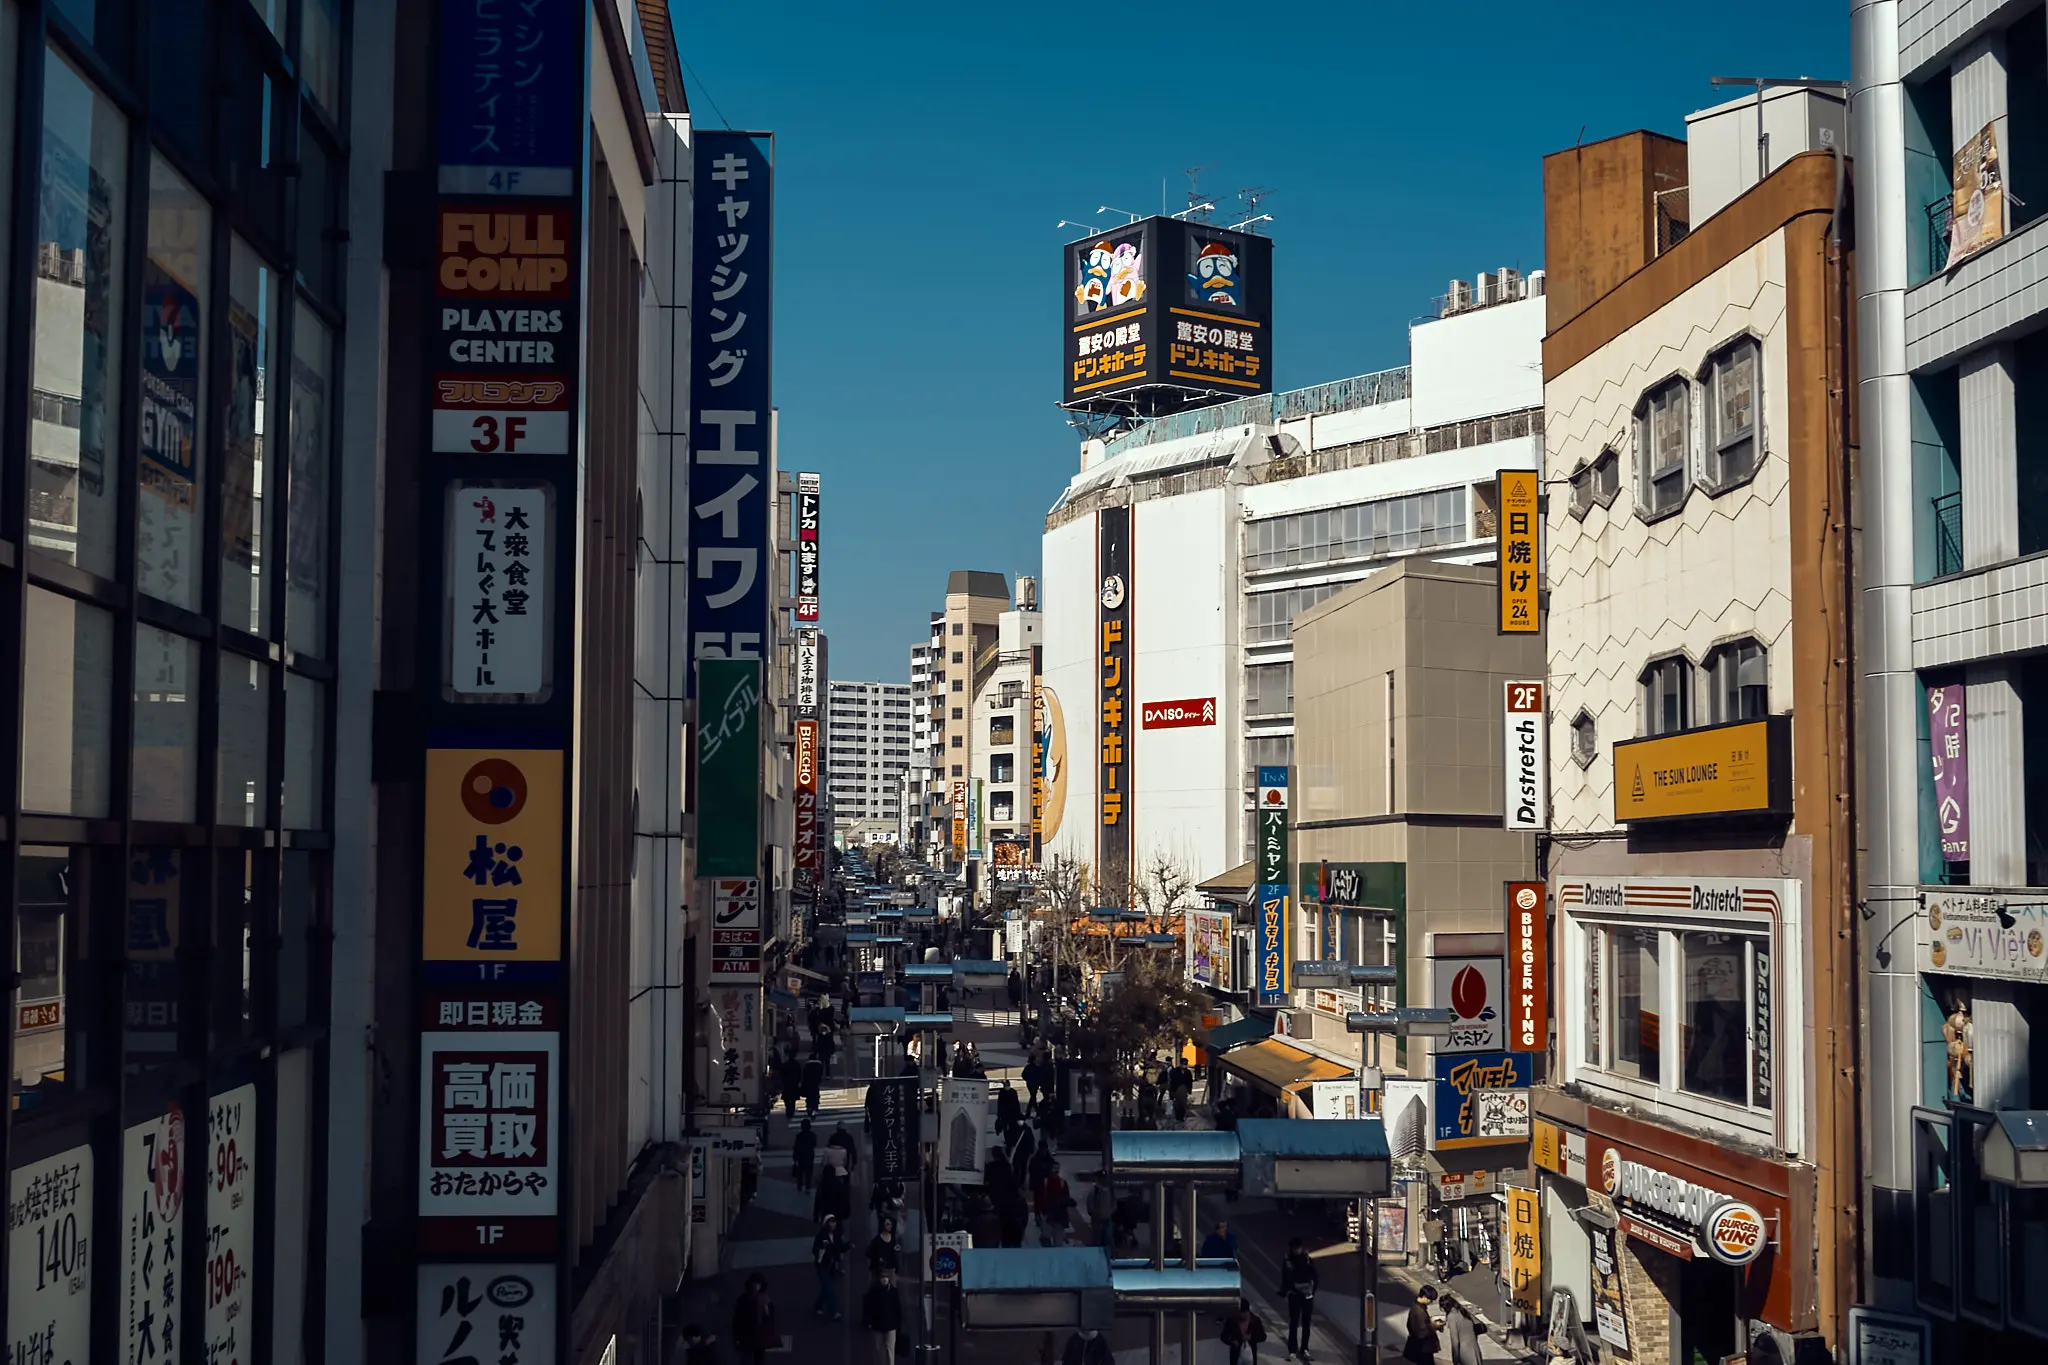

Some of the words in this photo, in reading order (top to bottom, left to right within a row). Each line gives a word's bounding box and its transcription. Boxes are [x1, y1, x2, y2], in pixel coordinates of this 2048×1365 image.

[488, 171, 521, 192] 4F
[442, 212, 565, 254] FULL
[440, 256, 568, 292] COMP
[708, 153, 750, 388] キャッシング
[442, 309, 563, 333] PLAYERS
[1176, 321, 1254, 352] 驚安の殿堂
[449, 339, 555, 363] CENTER
[1078, 322, 1141, 357] 驚安の殿堂
[470, 416, 528, 452] 3F
[694, 409, 760, 609] エイワ
[502, 506, 530, 615] 大衆食堂
[1508, 512, 1531, 592] 日焼け
[472, 529, 499, 687] てんぐ大ホール
[799, 604, 818, 616] 4F
[1511, 605, 1529, 618] 24
[800, 647, 815, 704] 八王子珈琲店
[800, 706, 814, 715] 2F
[1145, 706, 1184, 722] DAISO
[1514, 687, 1536, 708] 2F
[699, 683, 760, 752] エイブル
[800, 726, 811, 749] BIG
[800, 751, 811, 785] ECHO
[1517, 719, 1536, 824] Dr.stretch
[1653, 770, 1668, 787] THE
[1669, 767, 1685, 785] SUN
[1686, 762, 1719, 782] LOUNGE
[798, 793, 815, 863] カラオケ
[1265, 811, 1283, 881] バーミヤン
[463, 834, 524, 950] 松屋
[1267, 884, 1280, 896] 2F
[1585, 882, 1624, 906] Dr.stretch
[1692, 885, 1742, 913] Dr.stretch
[720, 931, 753, 943] たばこ
[1263, 899, 1281, 951] マツモト
[722, 961, 750, 972] ATM
[729, 946, 744, 957] 酒
[1521, 912, 1534, 990] BURGER
[477, 963, 508, 981] 1F
[1264, 952, 1280, 991] キヨシ
[439, 1001, 544, 1026] 即日現金
[1268, 993, 1280, 1004] 1F
[1521, 993, 1535, 1046] KING
[1756, 951, 1772, 1097] Dr.stretch
[1445, 1030, 1493, 1047] バーミヤン
[443, 1062, 538, 1110] 高価
[441, 1113, 538, 1160] 買取
[883, 1085, 898, 1173] ルネタワー八王子
[1440, 1127, 1452, 1138] 1F
[430, 1171, 548, 1196] おたからや
[1621, 1160, 1686, 1220] BURGER
[475, 1225, 504, 1246] 1F
[1715, 1228, 1759, 1246] KING
[1718, 1218, 1760, 1233] BURGER
[36, 1212, 87, 1292] 140円
[1514, 1198, 1535, 1292] 日焼け
[161, 1227, 176, 1365] 大衆食
[439, 1276, 484, 1365] ルノ
